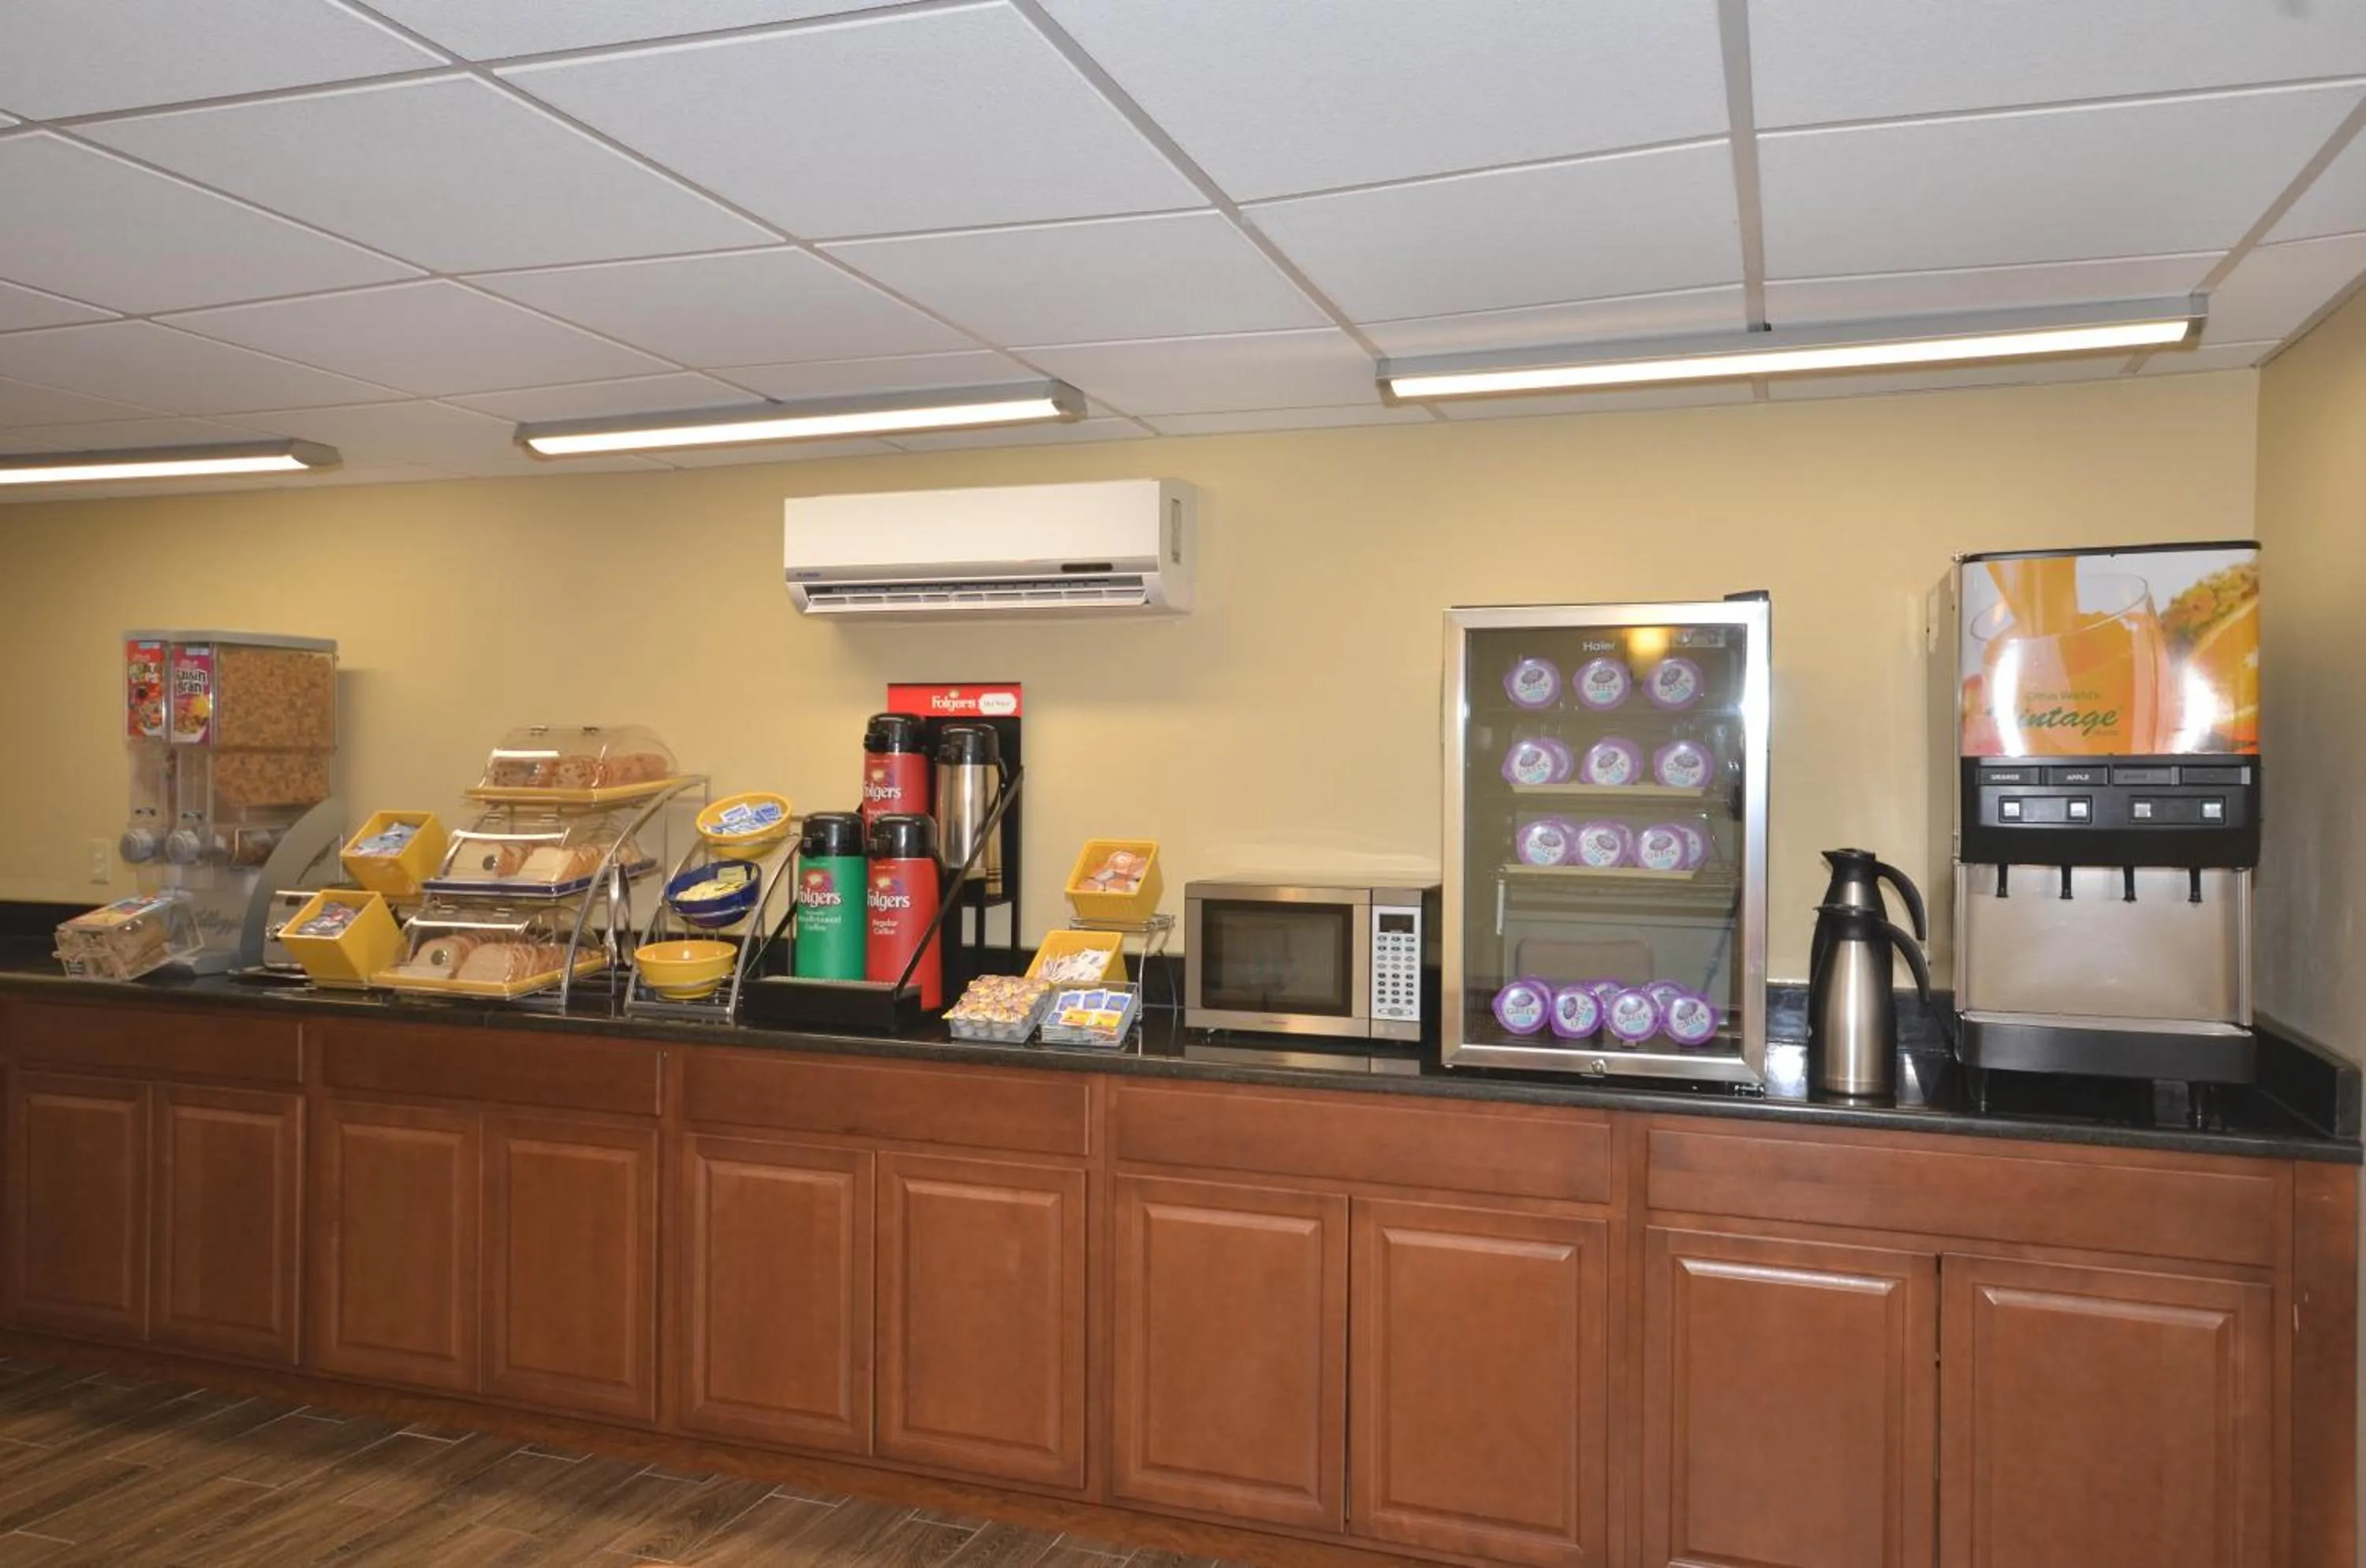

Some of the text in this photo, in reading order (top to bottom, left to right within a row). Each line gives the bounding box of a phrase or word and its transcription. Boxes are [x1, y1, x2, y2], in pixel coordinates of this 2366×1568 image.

[1583, 641, 1615, 651] Haier
[931, 696, 976, 713] Folgers
[2017, 706, 2118, 737] intage
